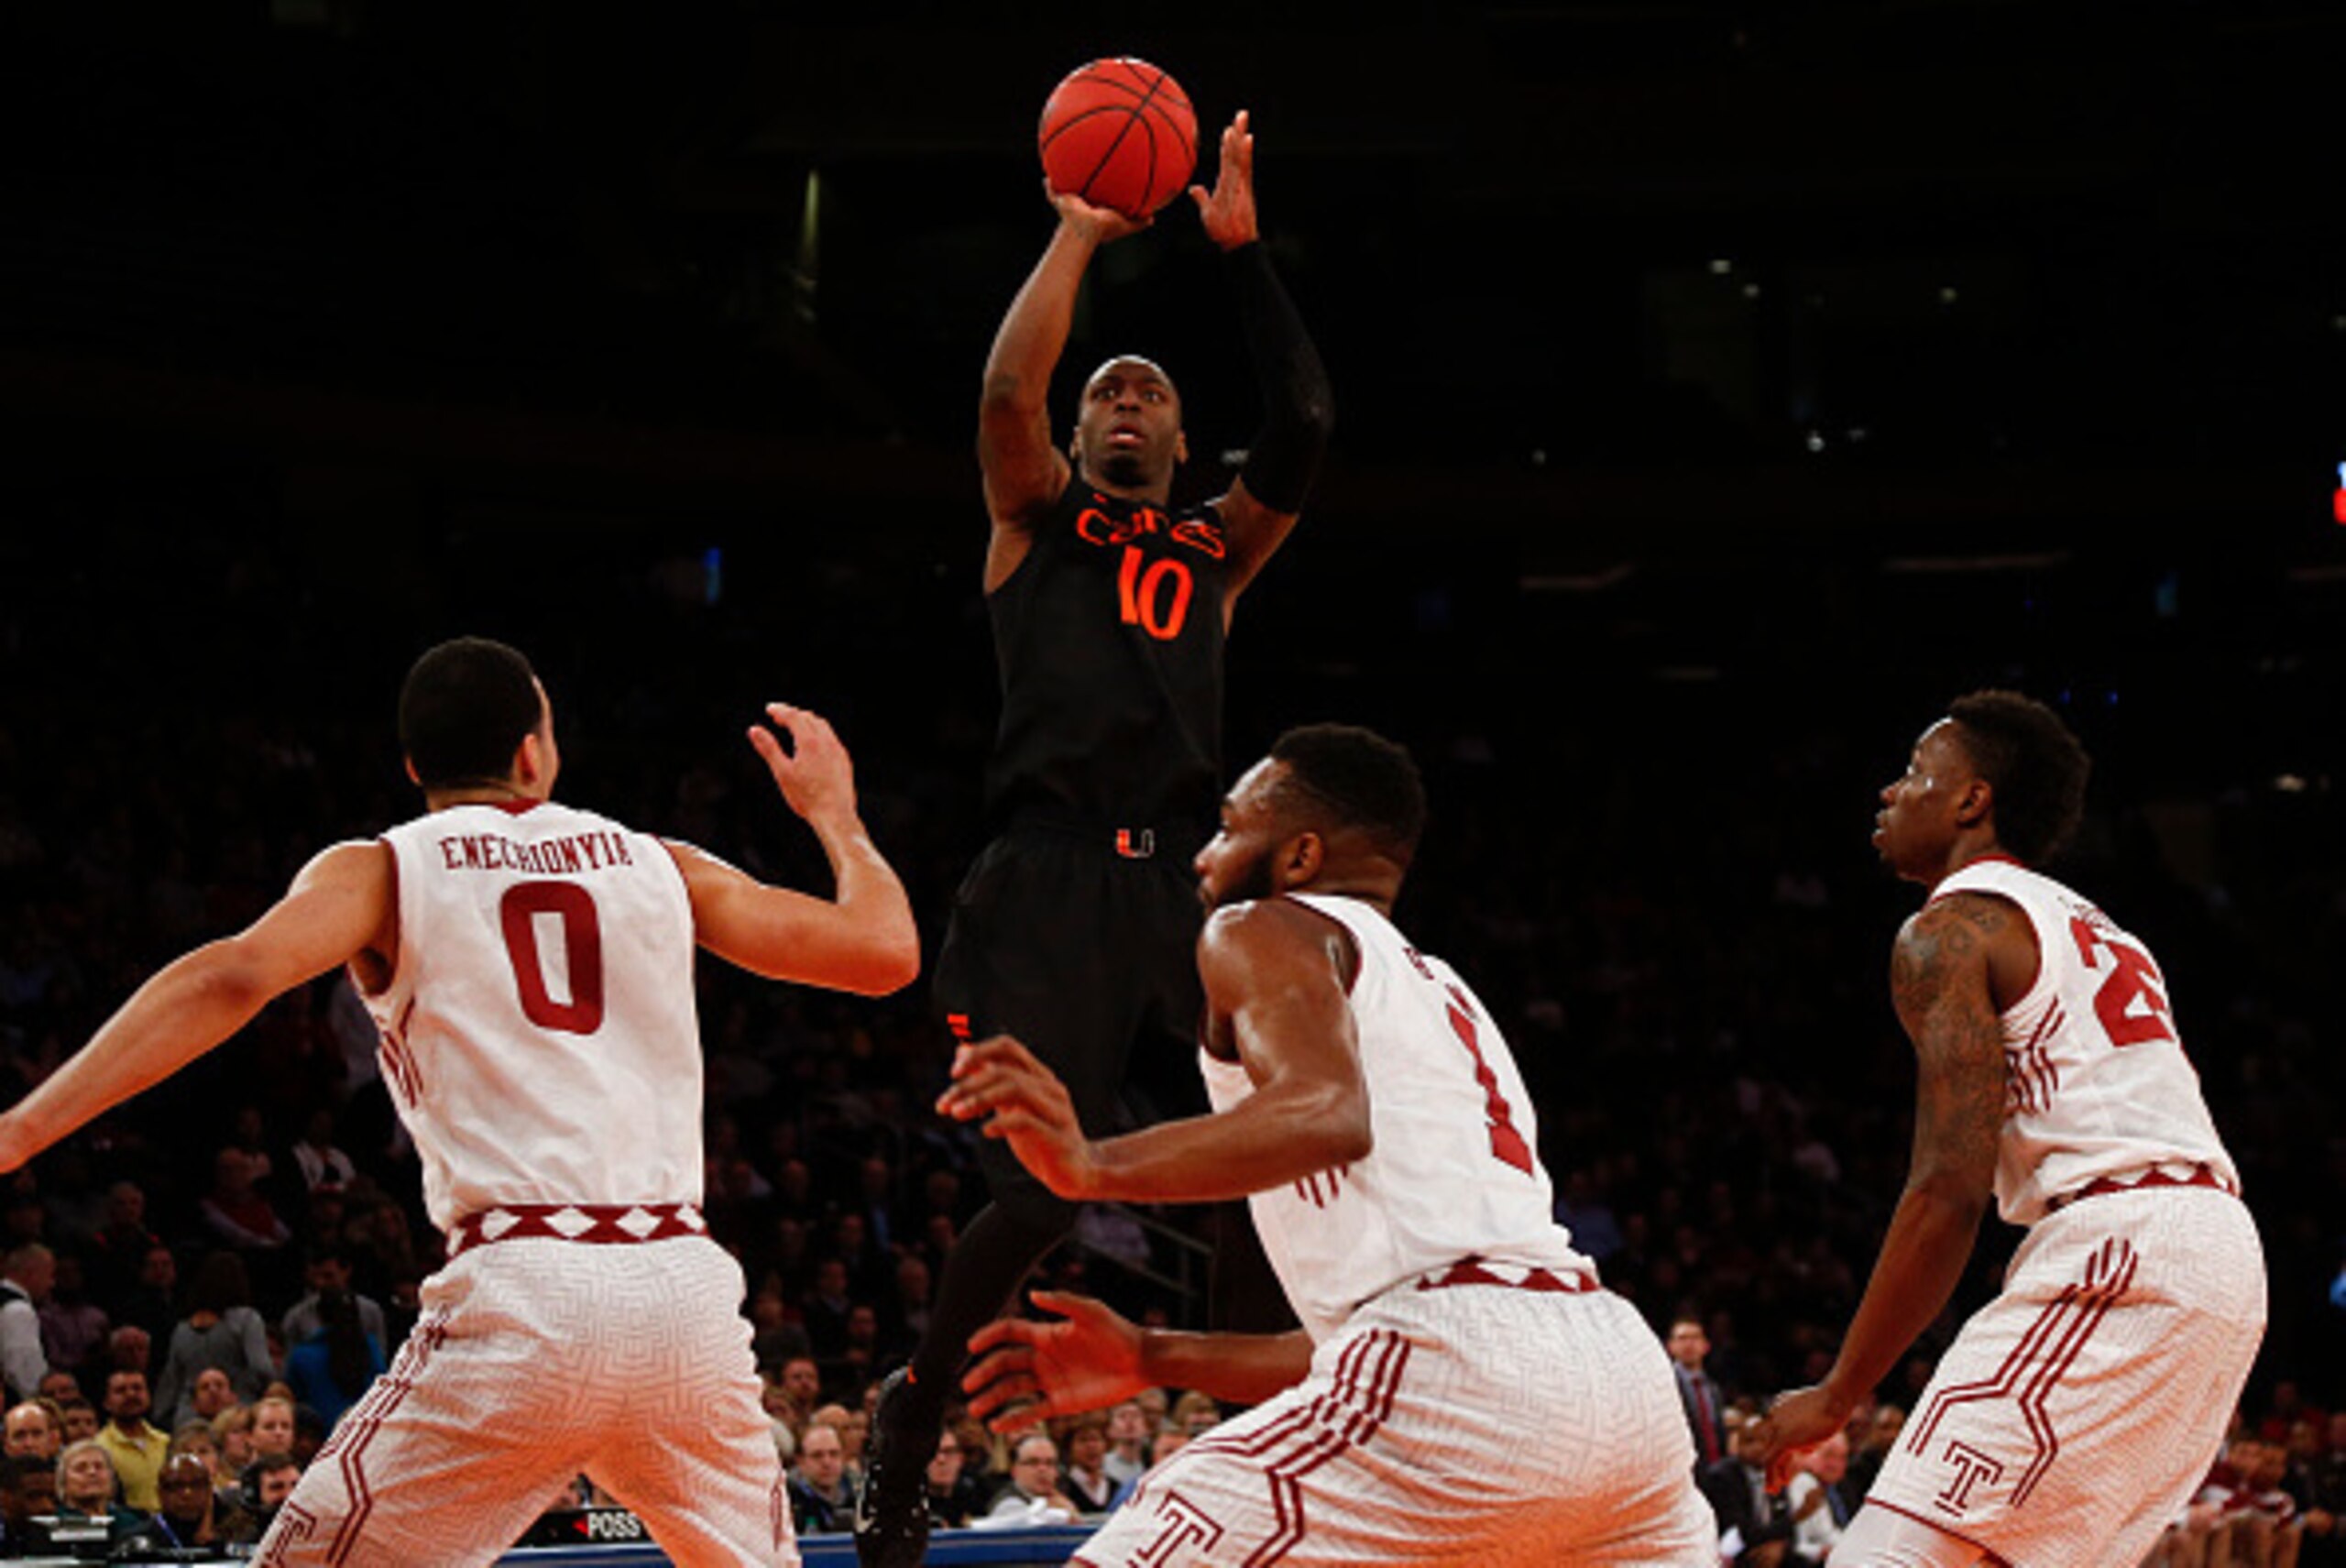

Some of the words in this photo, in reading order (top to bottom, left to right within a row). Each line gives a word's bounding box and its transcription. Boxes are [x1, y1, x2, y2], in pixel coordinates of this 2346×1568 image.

[1117, 544, 1194, 640] 10
[1116, 828, 1155, 858] U
[499, 880, 606, 1036] 0
[1445, 1002, 1535, 1179] 1
[1934, 1441, 2004, 1518] T
[587, 1511, 641, 1539] POSS
[1124, 1488, 1225, 1568] T
